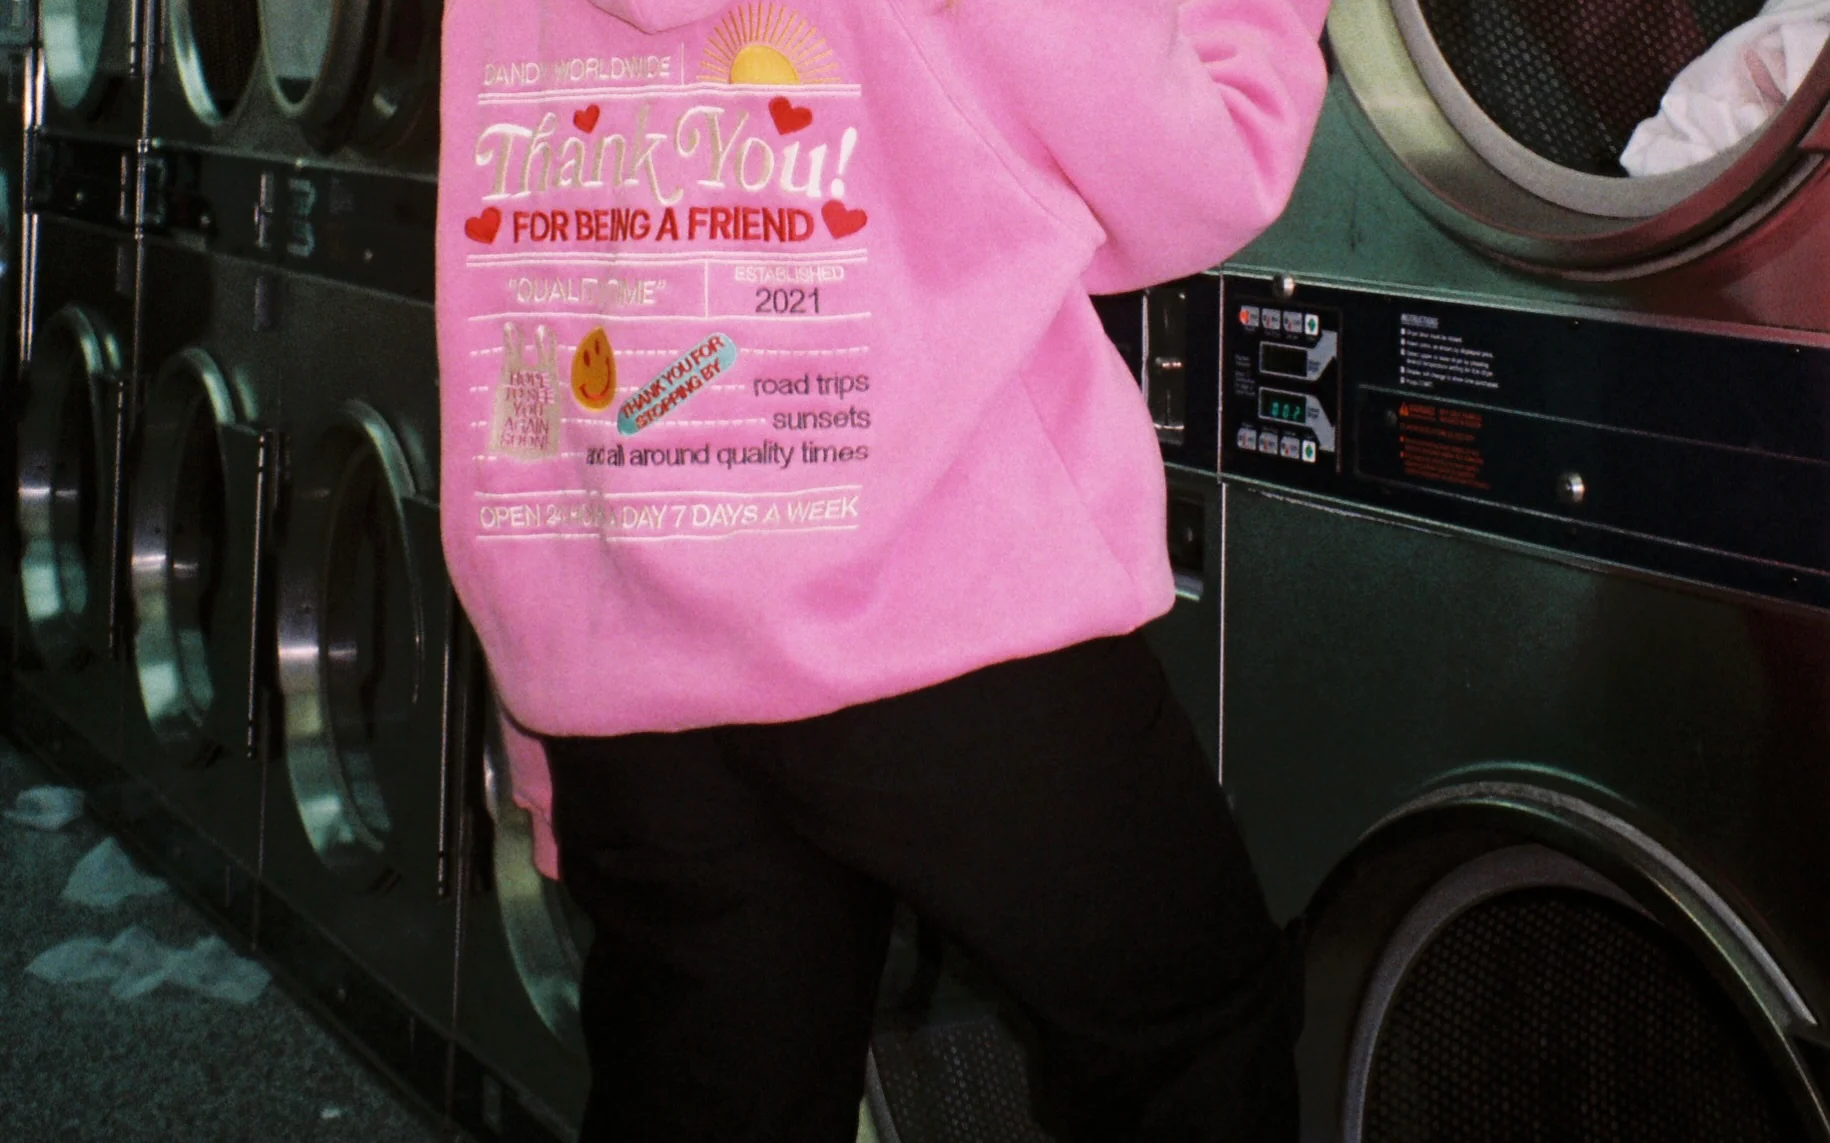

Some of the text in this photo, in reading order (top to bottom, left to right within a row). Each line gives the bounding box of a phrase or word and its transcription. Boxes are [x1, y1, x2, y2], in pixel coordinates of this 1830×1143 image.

[483, 62, 549, 86] DAND
[476, 102, 857, 206] Thank You!
[512, 206, 814, 243] FOR BEING A FRIEND
[735, 265, 845, 283] ESTABLISHED
[755, 287, 820, 313] 2021
[622, 336, 724, 418] THANK YOU FOR
[753, 373, 870, 400] road trips
[635, 357, 721, 430] STOPPING BY
[772, 406, 871, 430] sunsets
[607, 442, 626, 466] all
[630, 442, 711, 466] around
[716, 439, 794, 470] quality
[802, 440, 869, 465] times
[479, 504, 541, 529] OPEN
[622, 505, 668, 529] DAY
[671, 505, 687, 528] 7
[692, 504, 759, 528] DAYS
[763, 503, 780, 526] A
[787, 496, 860, 524] WEEK
